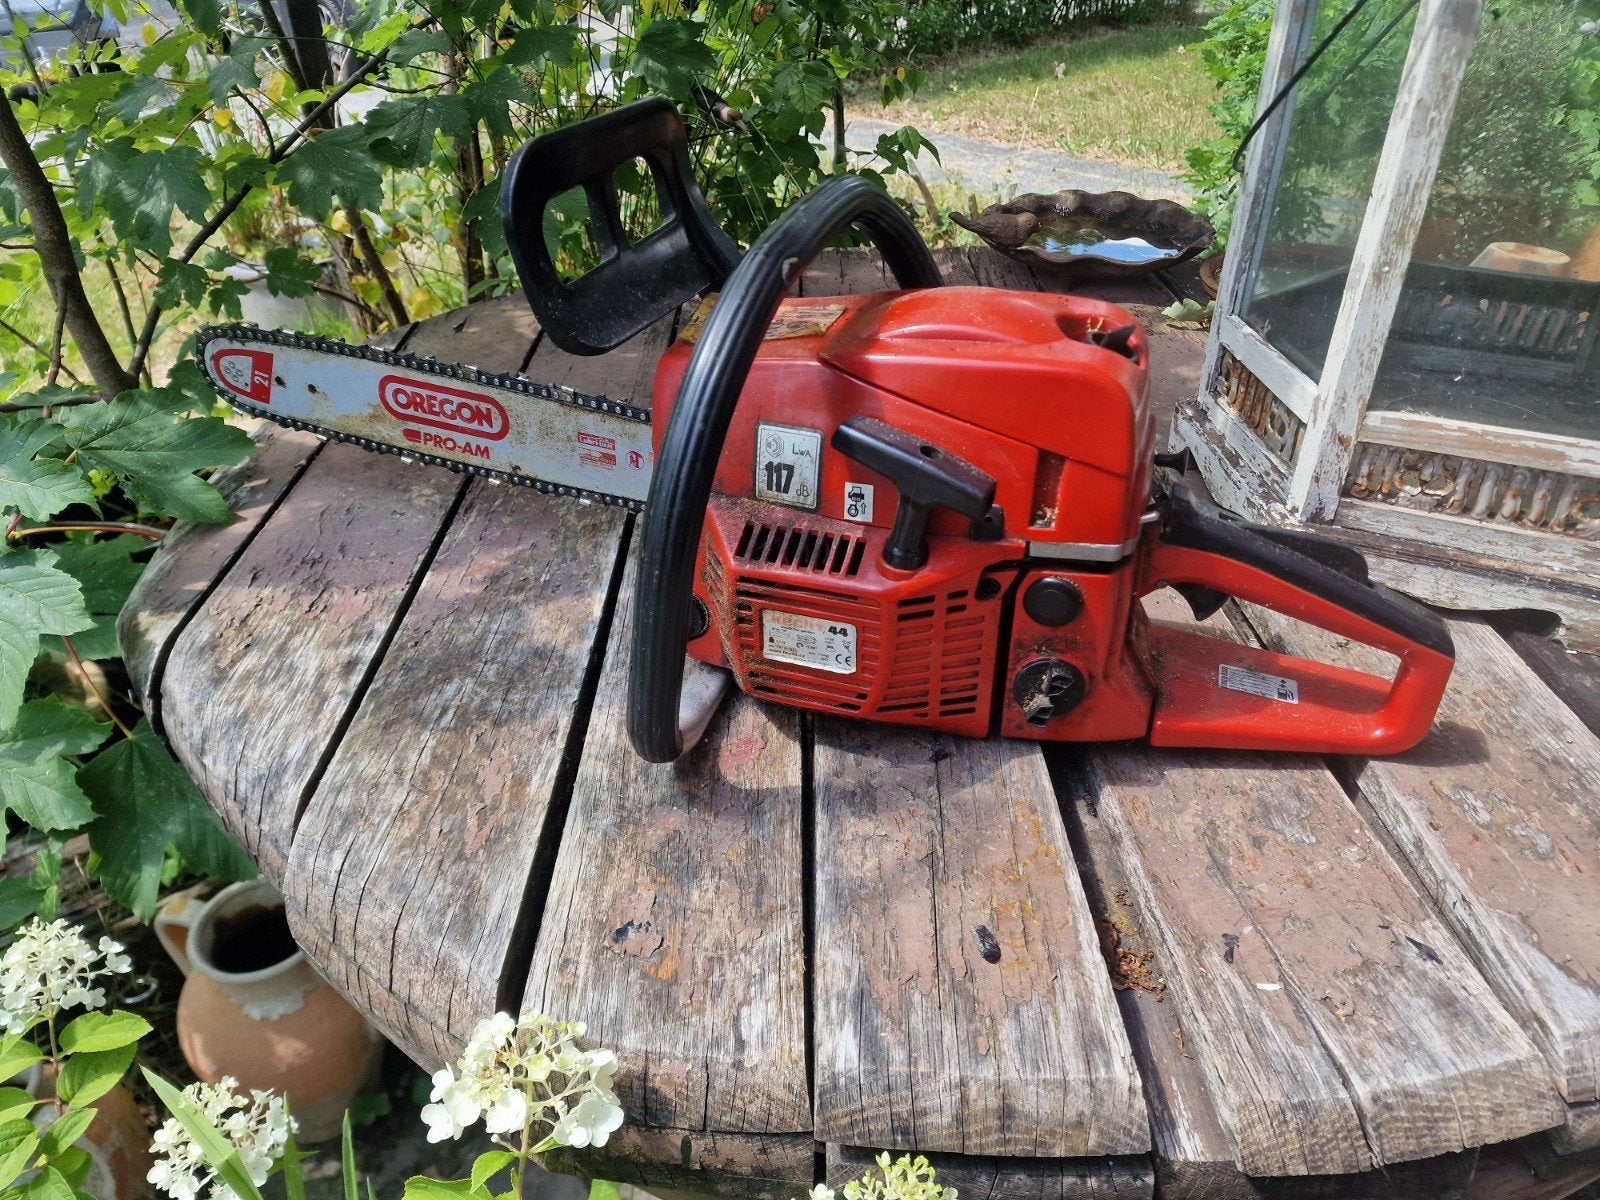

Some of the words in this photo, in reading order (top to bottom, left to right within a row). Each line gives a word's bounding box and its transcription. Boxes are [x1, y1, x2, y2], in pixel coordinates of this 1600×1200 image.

[253, 370, 270, 388] 21
[391, 387, 494, 429] OREGON
[423, 432, 491, 460] PRO-AM
[765, 461, 795, 494] 117
[796, 484, 810, 498] dB
[828, 625, 848, 637] 44
